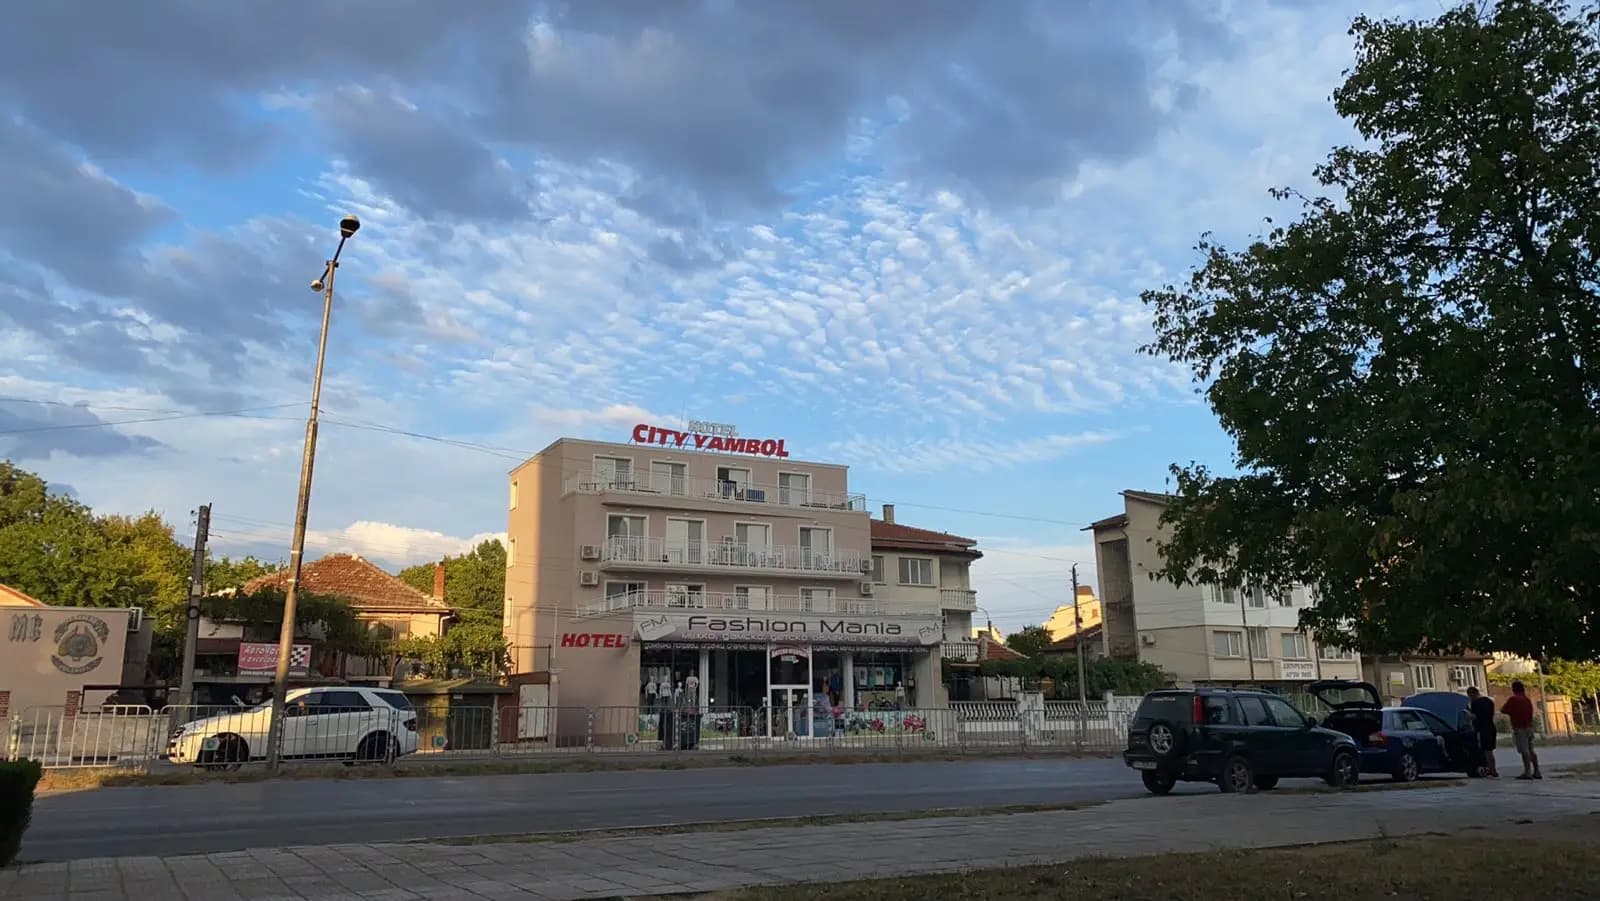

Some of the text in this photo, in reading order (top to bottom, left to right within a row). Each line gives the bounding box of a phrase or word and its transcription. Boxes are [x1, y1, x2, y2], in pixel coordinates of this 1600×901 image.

[688, 420, 738, 437] HOTEL
[632, 424, 789, 458] CITY YAMBOL
[639, 614, 668, 633] FM
[688, 615, 902, 635] Fashion Mania
[918, 621, 939, 637] FM
[560, 632, 625, 648] HOTEL
